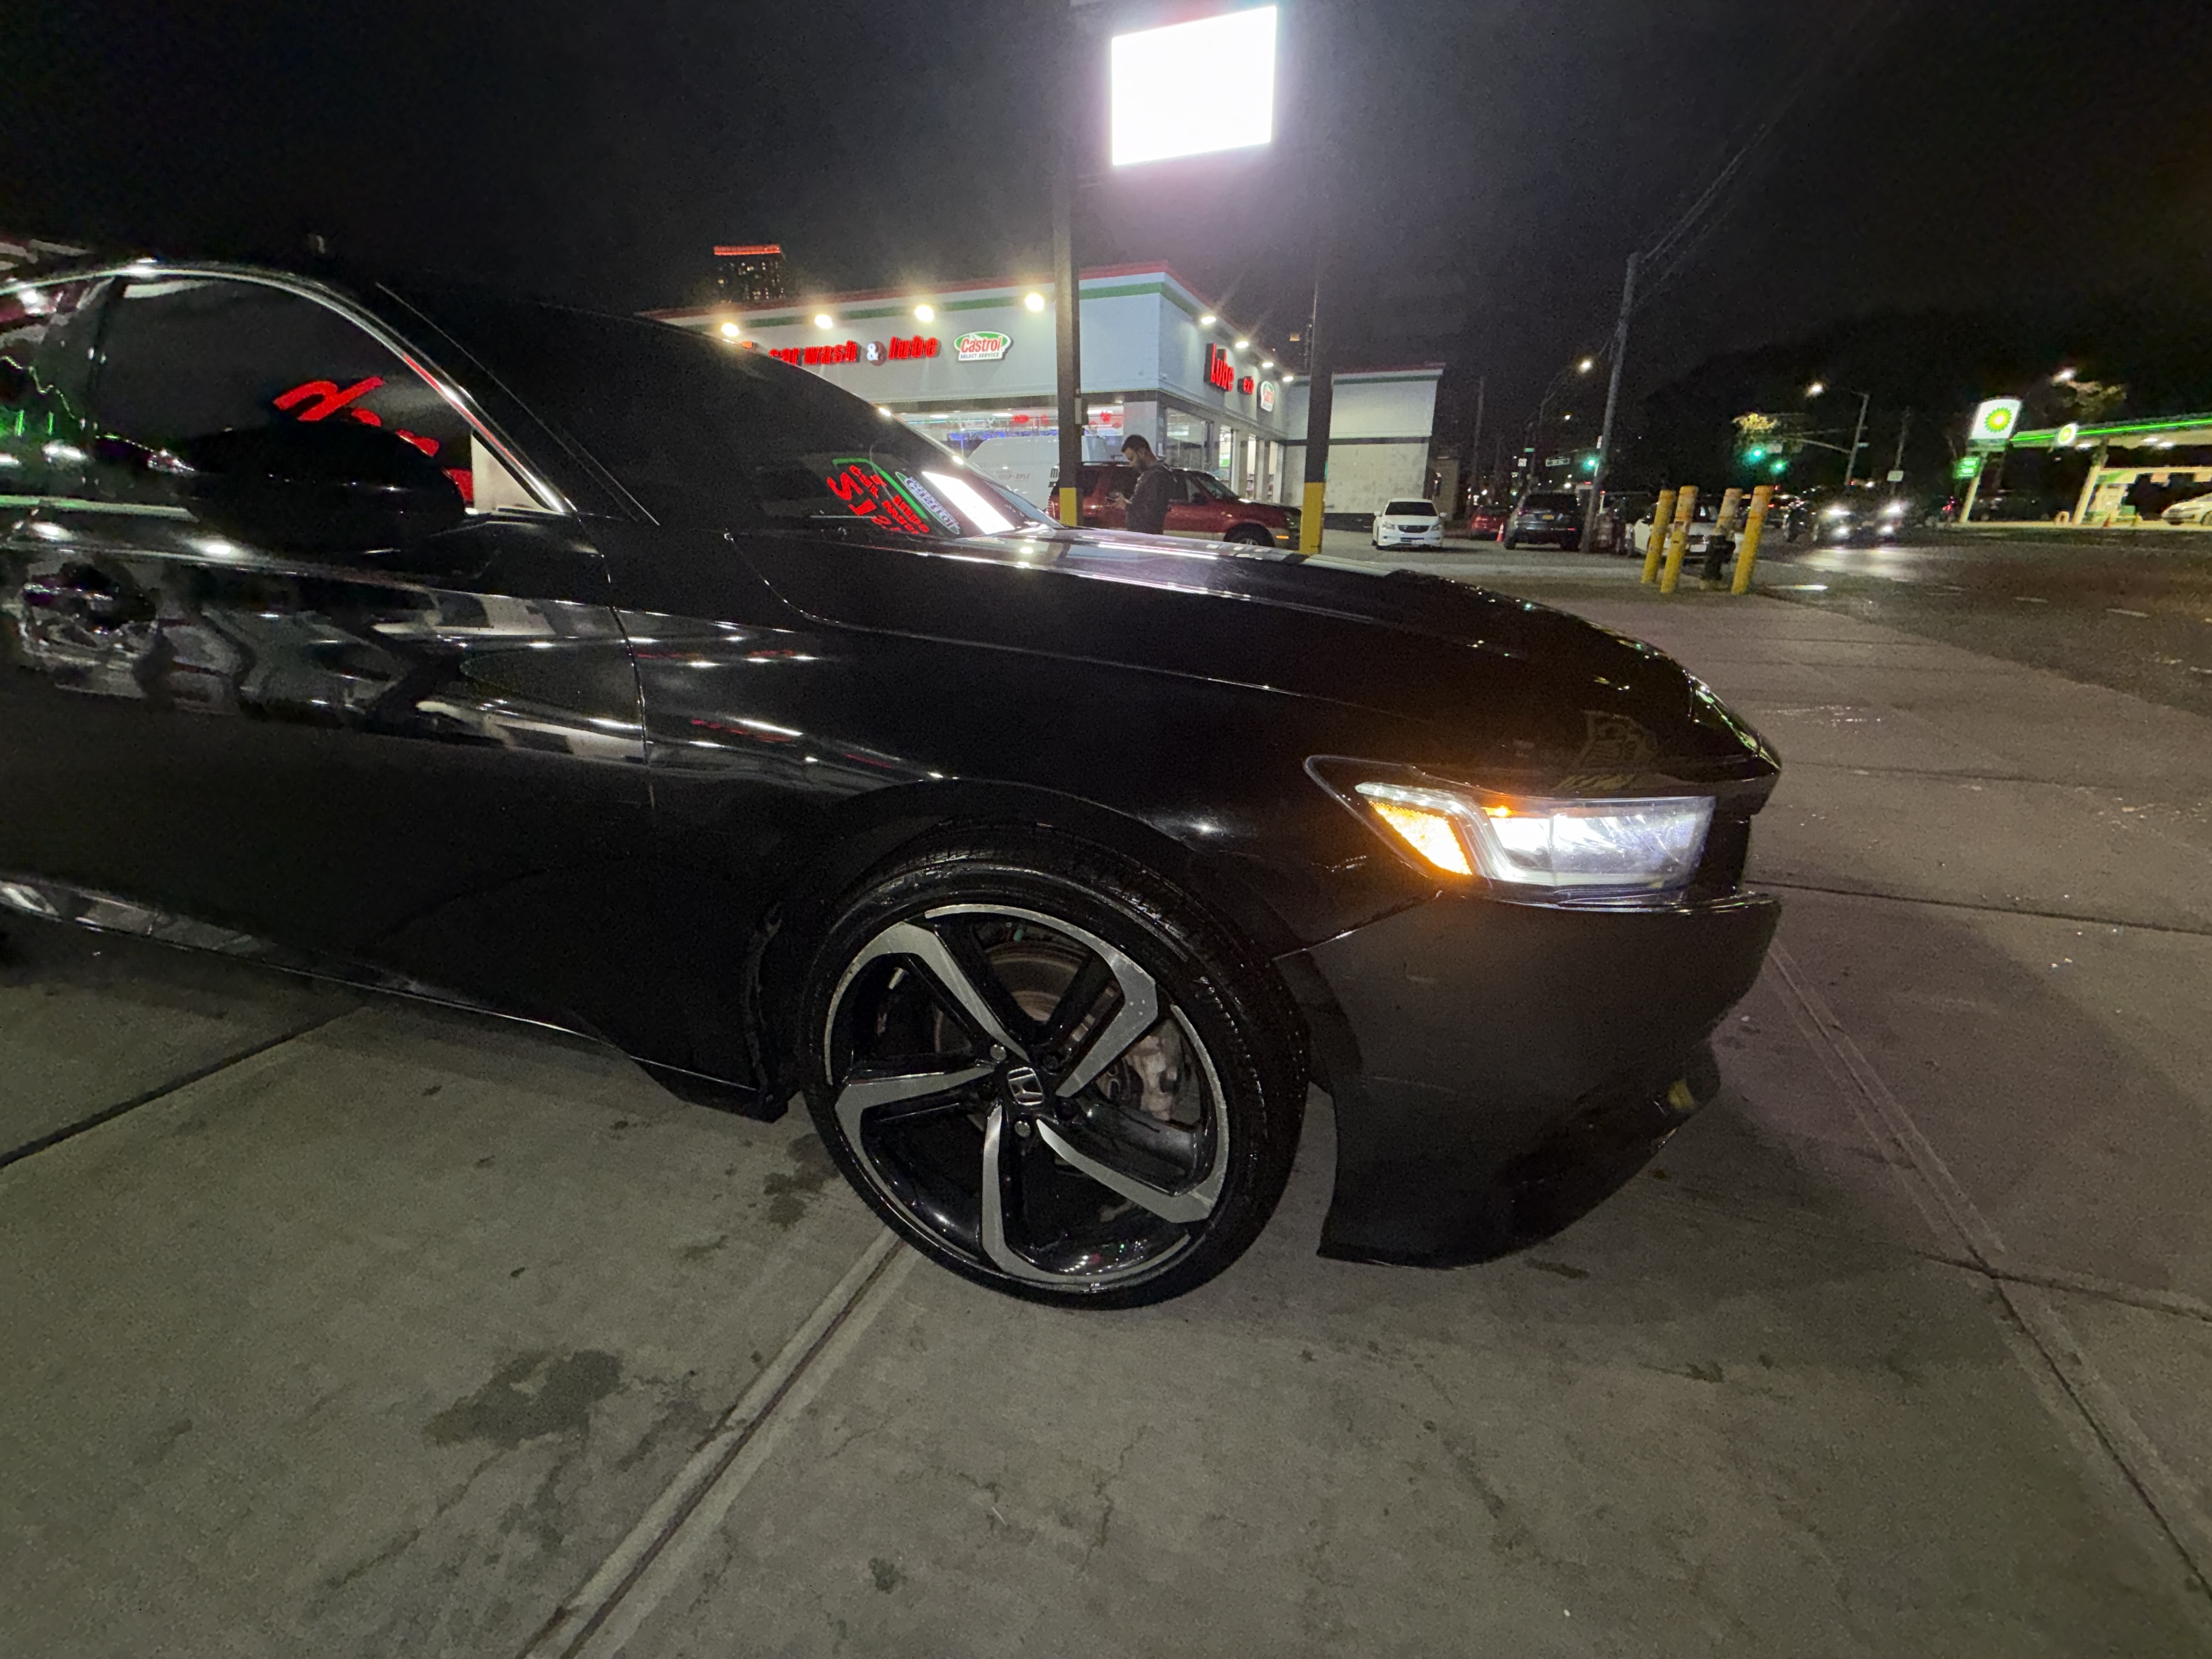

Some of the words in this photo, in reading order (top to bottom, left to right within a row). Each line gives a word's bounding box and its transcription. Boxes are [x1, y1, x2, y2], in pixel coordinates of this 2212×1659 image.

[804, 340, 857, 364] wash
[867, 343, 879, 361] &
[889, 335, 938, 360] lube
[961, 336, 1002, 353] Castrol
[1210, 342, 1234, 392] lube
